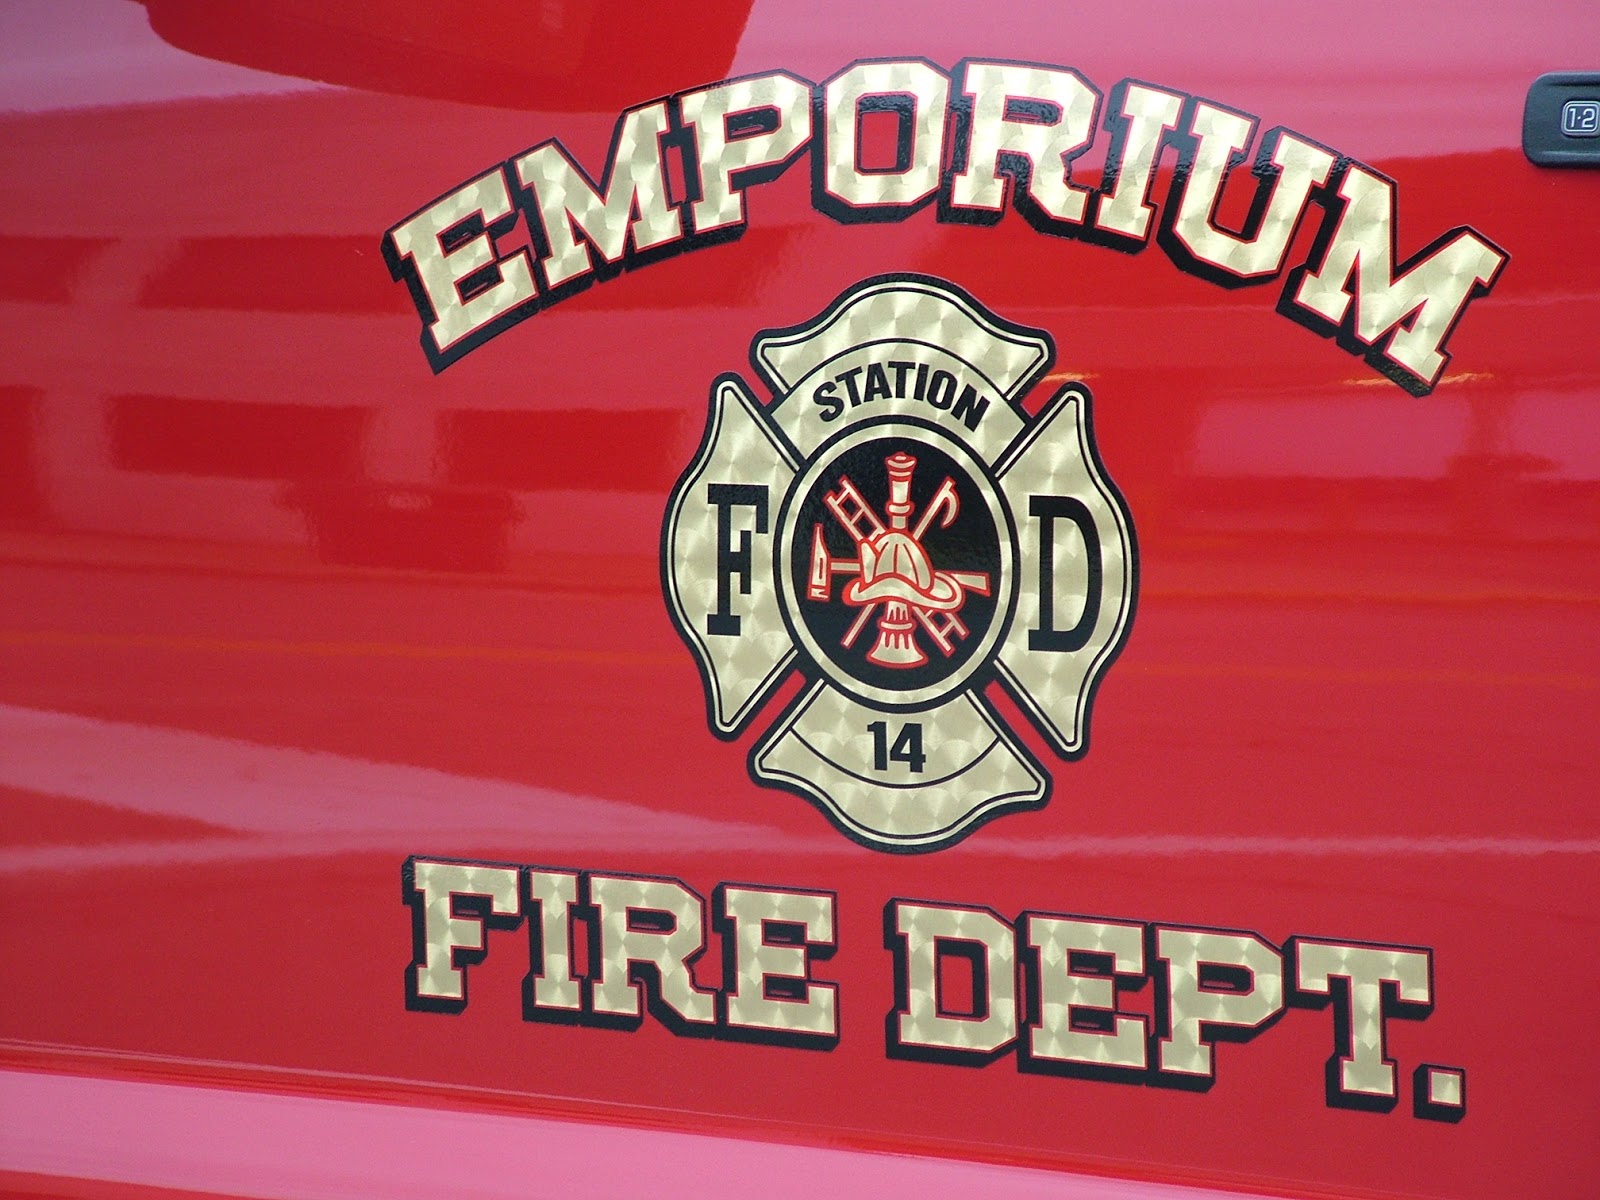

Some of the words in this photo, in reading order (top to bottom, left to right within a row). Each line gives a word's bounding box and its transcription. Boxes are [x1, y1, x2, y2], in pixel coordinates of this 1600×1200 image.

[382, 57, 1508, 396] EMPORIUM
[813, 361, 990, 432] STATION
[706, 484, 768, 636] F
[1028, 495, 1099, 651] D
[867, 721, 925, 773] 14
[404, 855, 838, 1050] FIRE
[885, 898, 1466, 1122] DEPT.
